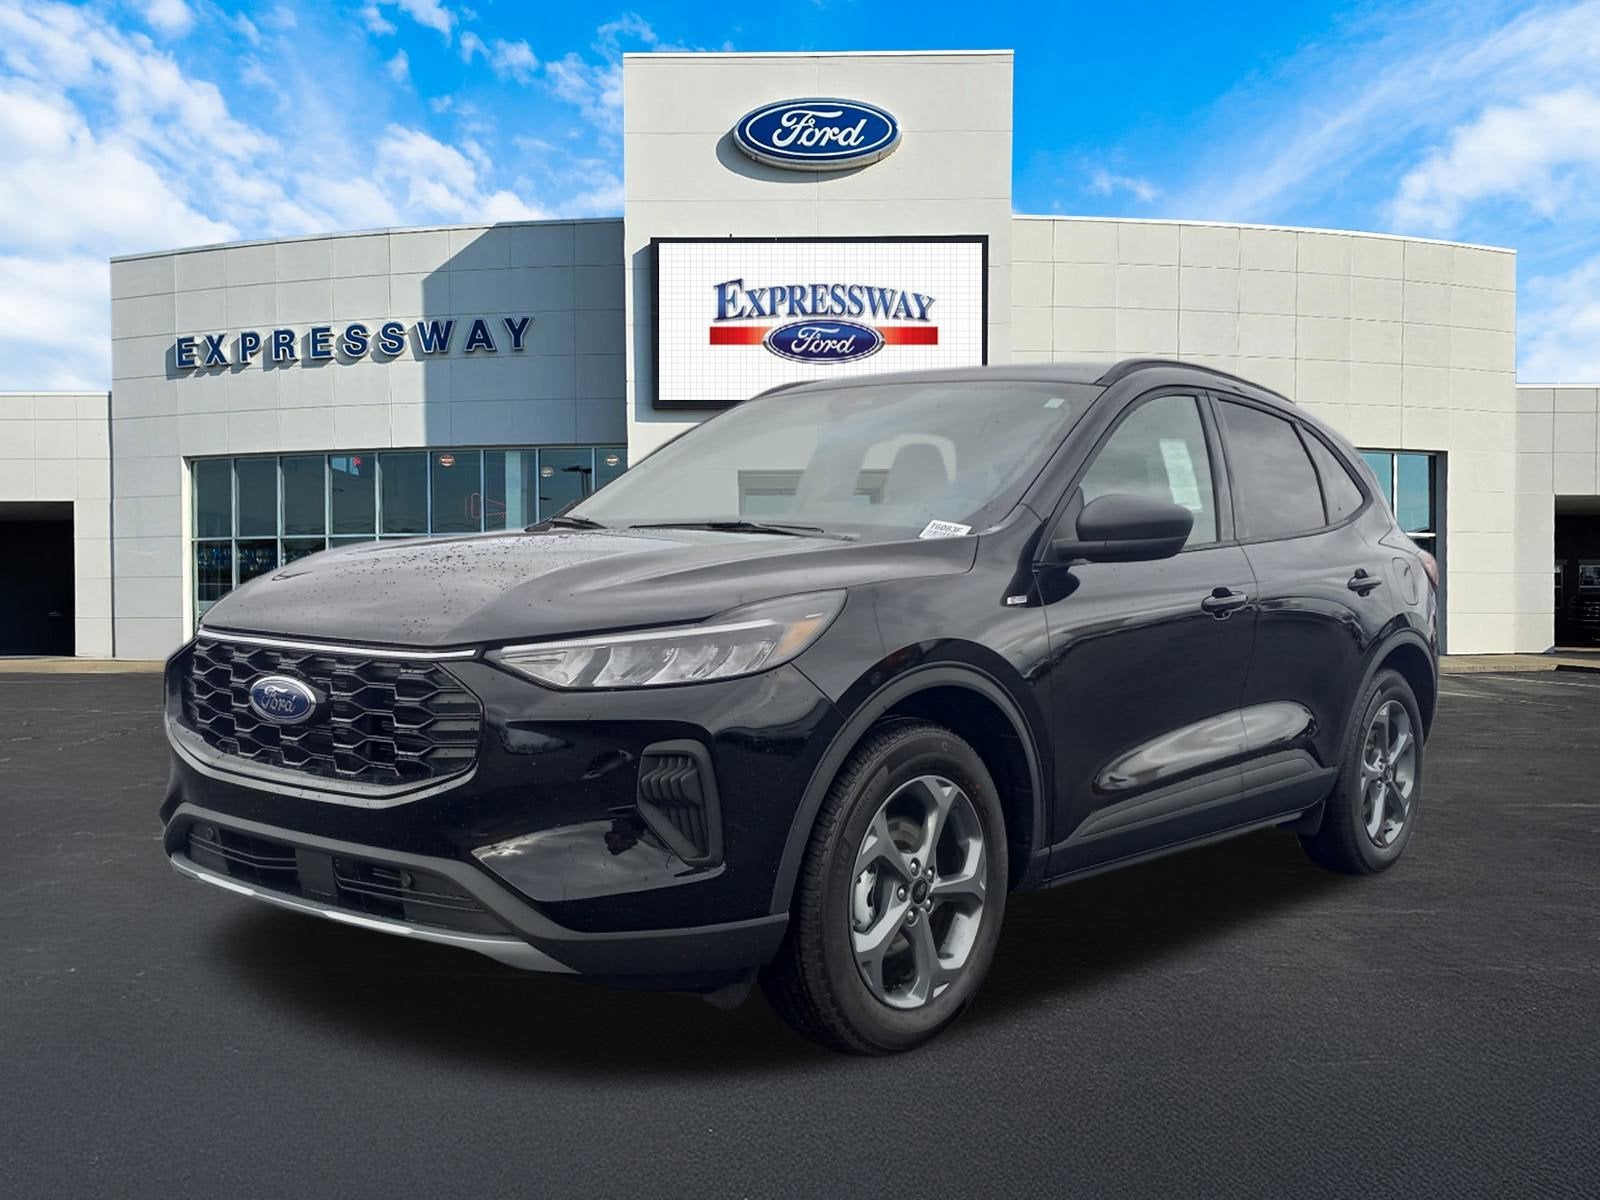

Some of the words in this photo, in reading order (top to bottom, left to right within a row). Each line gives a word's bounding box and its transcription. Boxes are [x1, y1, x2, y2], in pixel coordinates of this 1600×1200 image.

[772, 109, 868, 147] Ford
[713, 278, 936, 322] EXPRESSWAY
[175, 316, 534, 369] EXPRESSWAY
[790, 326, 855, 354] Ford
[260, 685, 297, 713] Ford
